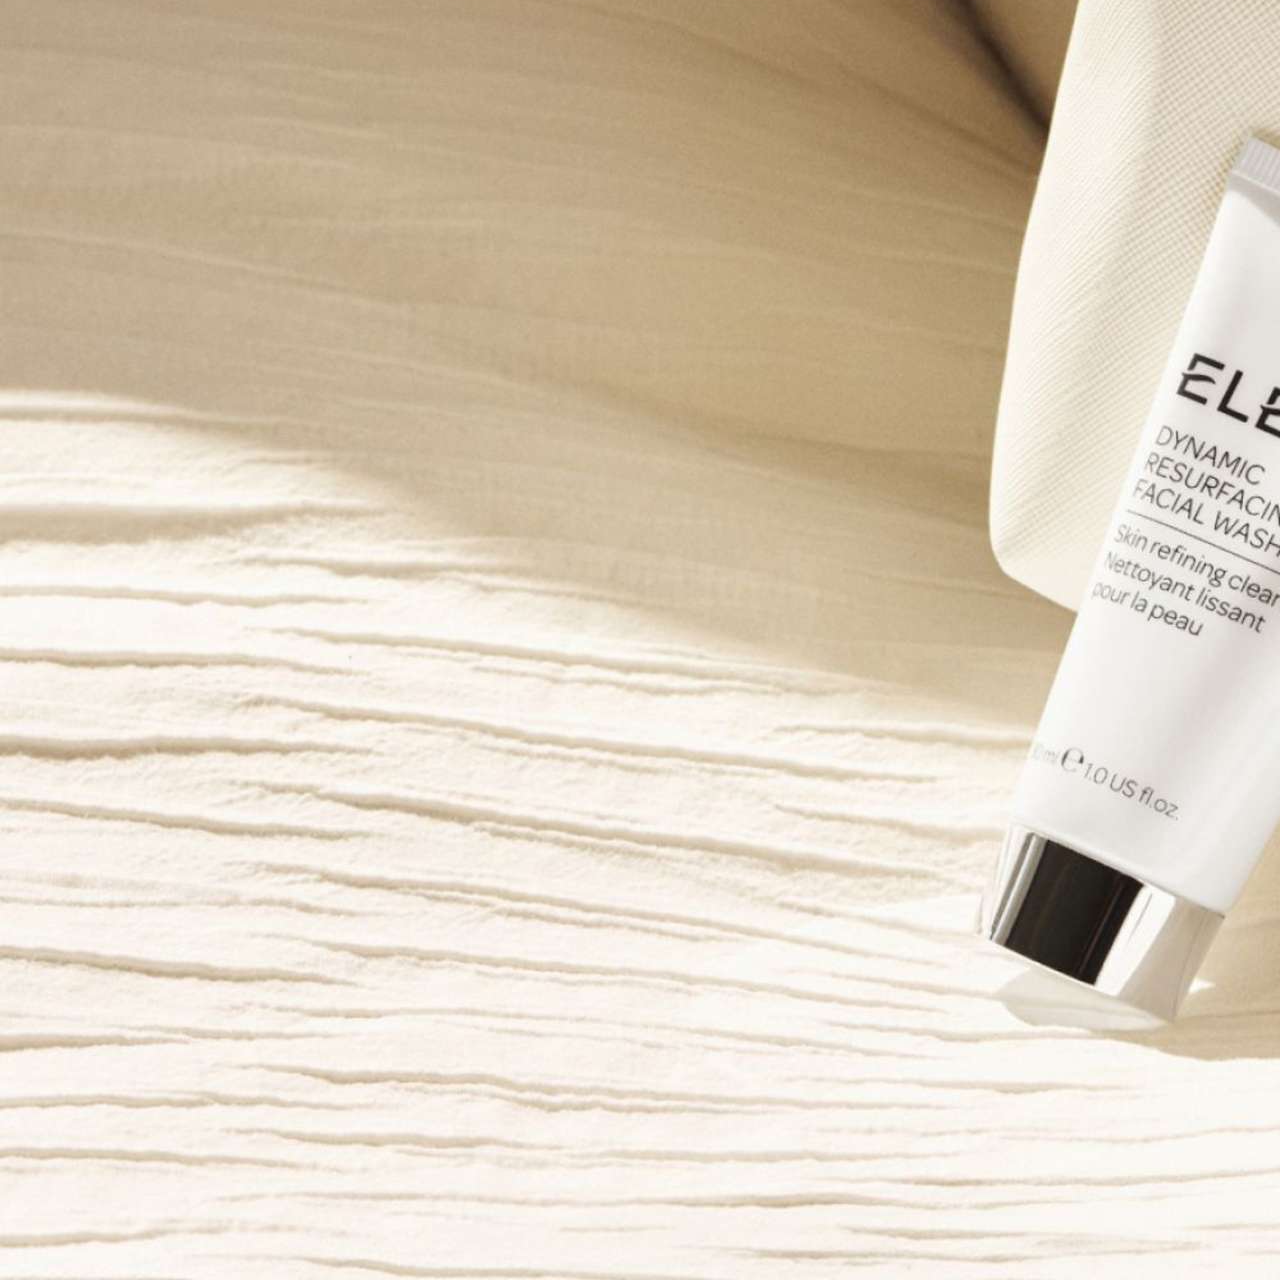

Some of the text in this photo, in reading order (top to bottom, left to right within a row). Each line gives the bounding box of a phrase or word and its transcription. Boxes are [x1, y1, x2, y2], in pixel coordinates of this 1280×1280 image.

[1155, 425, 1266, 485] DYNAMIC
[1133, 478, 1205, 526] FACIAL
[1113, 523, 1148, 552] Skin
[1149, 538, 1228, 588] refining
[1091, 580, 1205, 637] pour la peau
[1104, 551, 1267, 634] Nettoyant lissant
[1109, 773, 1138, 798] US
